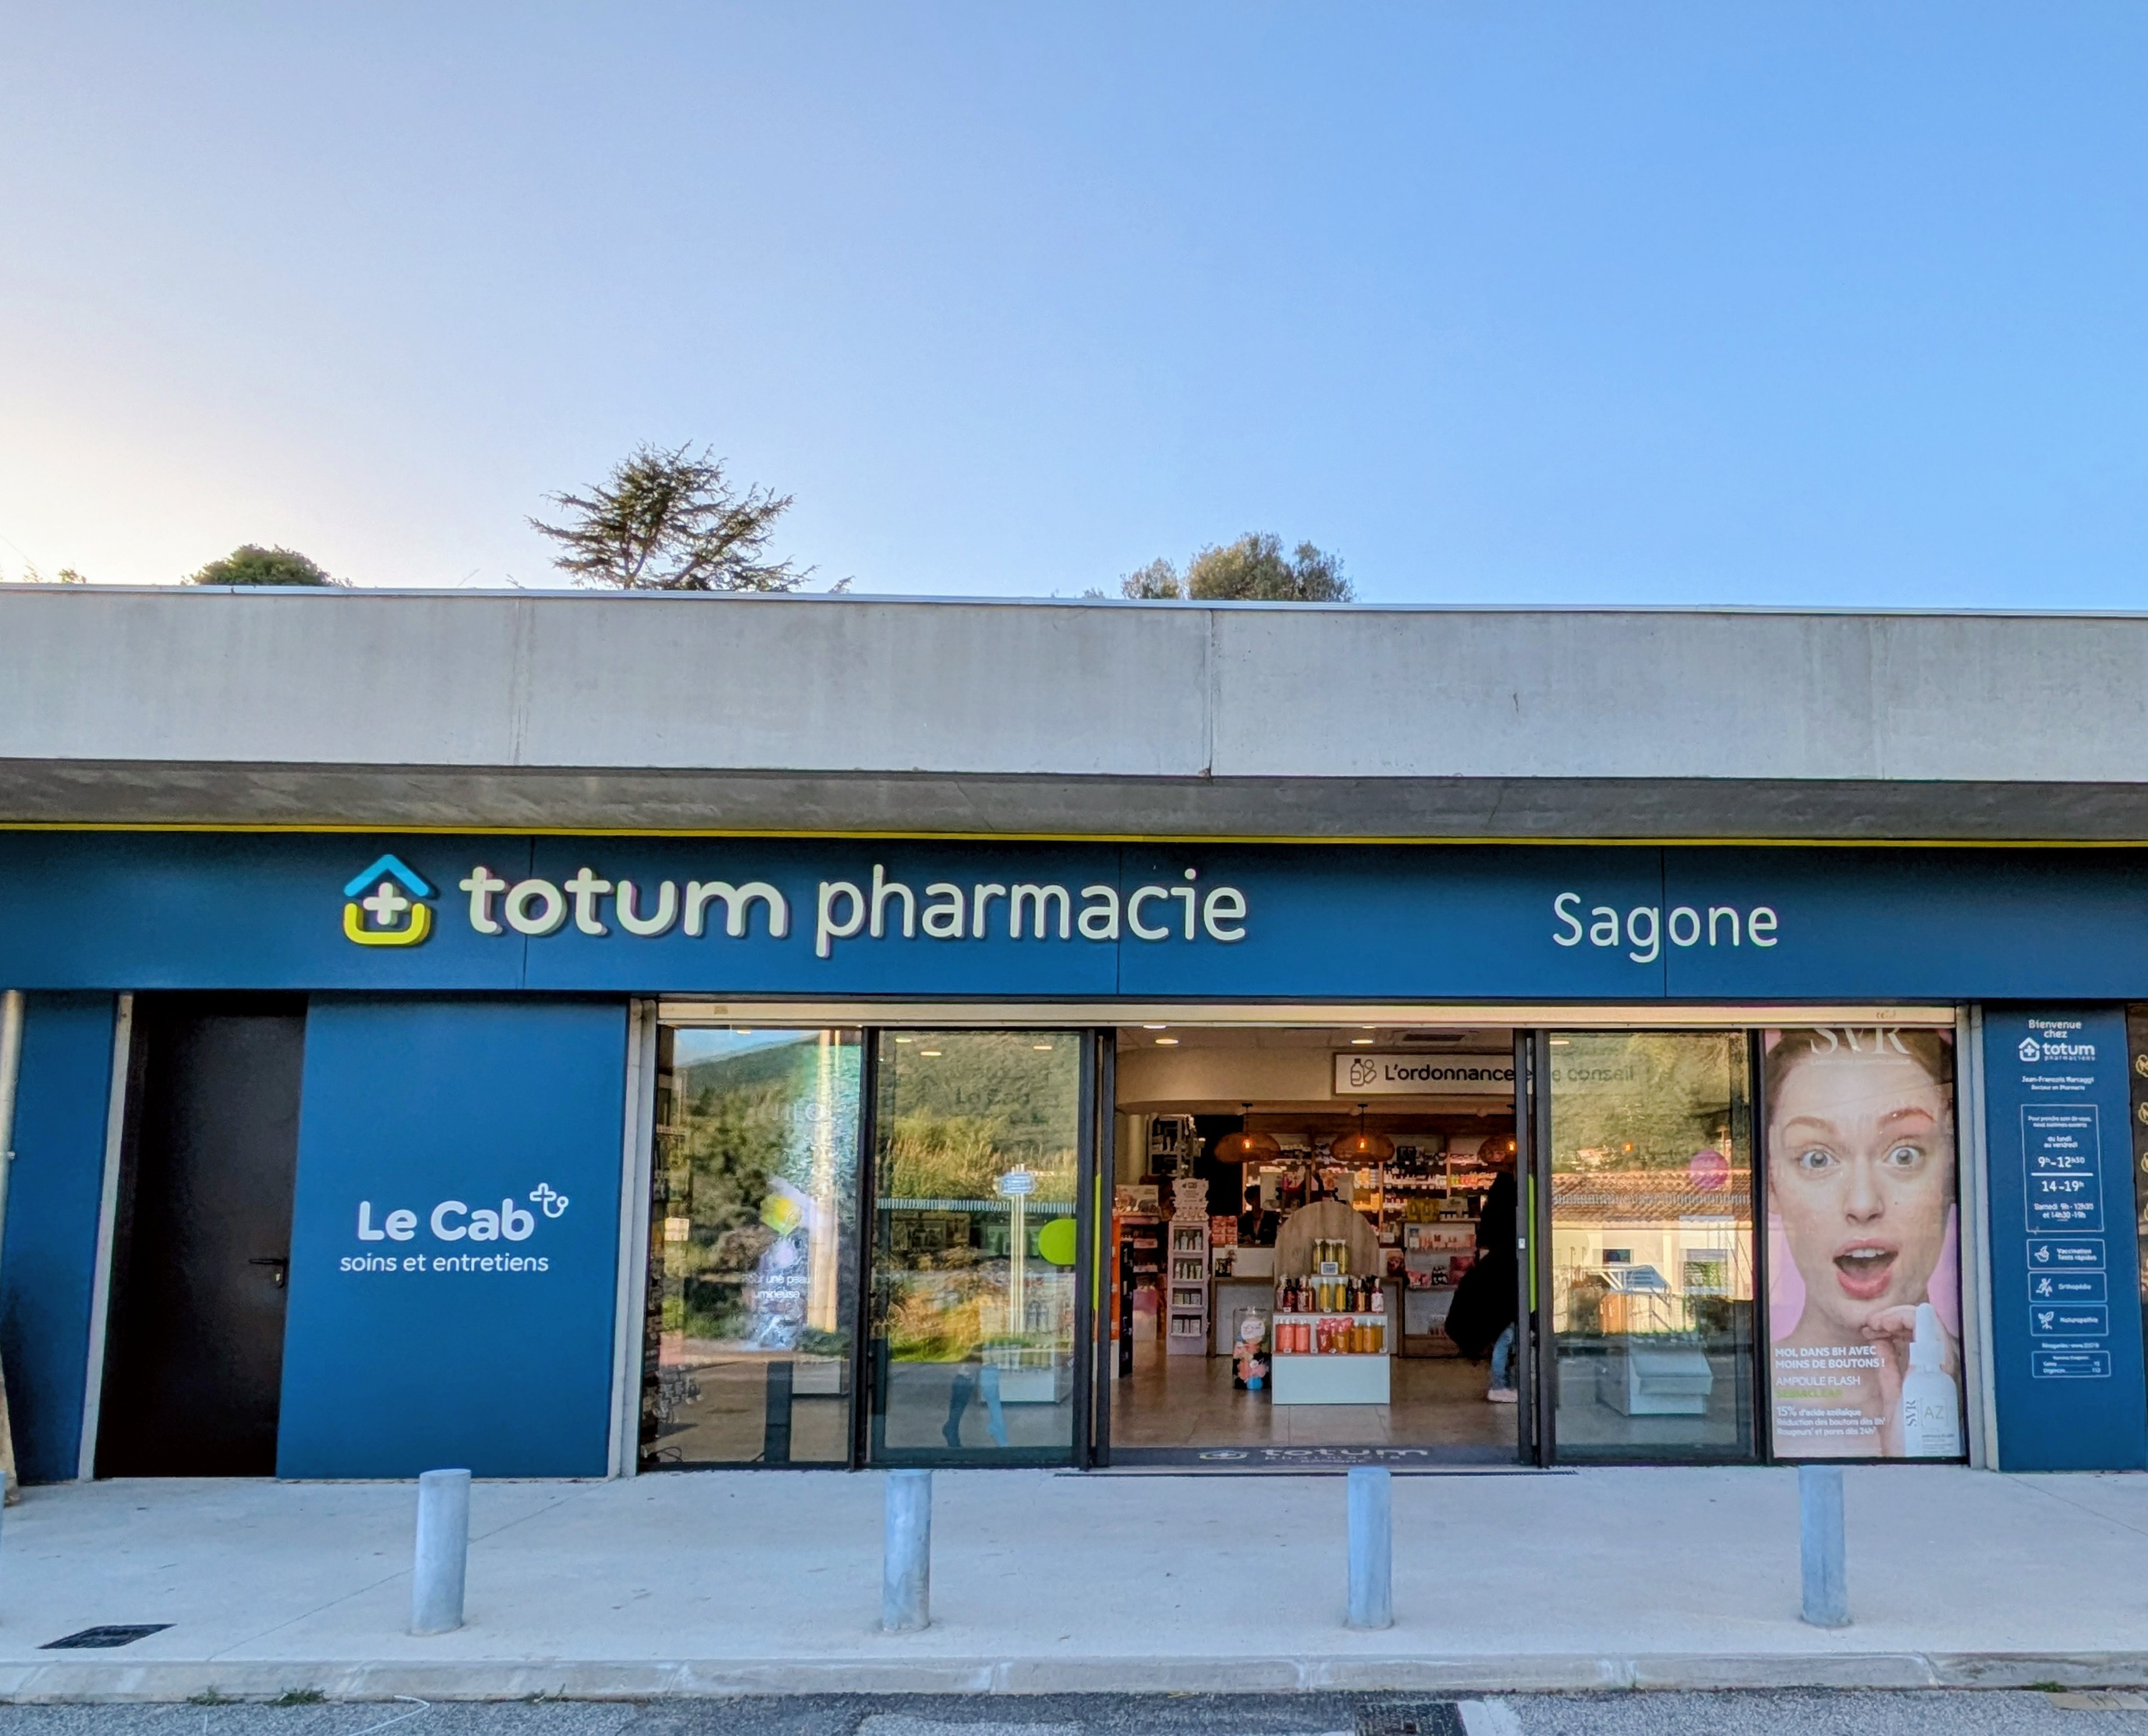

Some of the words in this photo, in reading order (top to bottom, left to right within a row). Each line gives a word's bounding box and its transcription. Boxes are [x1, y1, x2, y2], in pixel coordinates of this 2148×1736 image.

[460, 867, 790, 938] totum
[816, 864, 1247, 958] pharmacie
[1552, 892, 1778, 964] Sagone
[2029, 1019, 2082, 1029] Bienvenue
[2044, 1029, 2068, 1038] chez
[2042, 1042, 2096, 1055] totum
[1385, 1064, 1515, 1081] L'ordonnance
[1568, 1065, 1634, 1082] conseil
[358, 1201, 418, 1241] Le
[431, 1198, 534, 1241] Cab
[340, 1252, 397, 1272] soins
[403, 1254, 426, 1272] et
[433, 1253, 549, 1272] entretiens
[1800, 1347, 1830, 1357] DANS
[1832, 1347, 1846, 1356] 8H
[1849, 1346, 1876, 1355] AVEC
[1775, 1359, 1809, 1368] MOINS
[1812, 1359, 1826, 1368] DE
[1829, 1358, 1879, 1368] BOUTONS
[1776, 1376, 1826, 1386] AMPOULE
[1828, 1376, 1860, 1386] FLASH
[1777, 1406, 1797, 1417] 15%
[1924, 1405, 1944, 1419] AZ
[1261, 1448, 1429, 1456] totum
